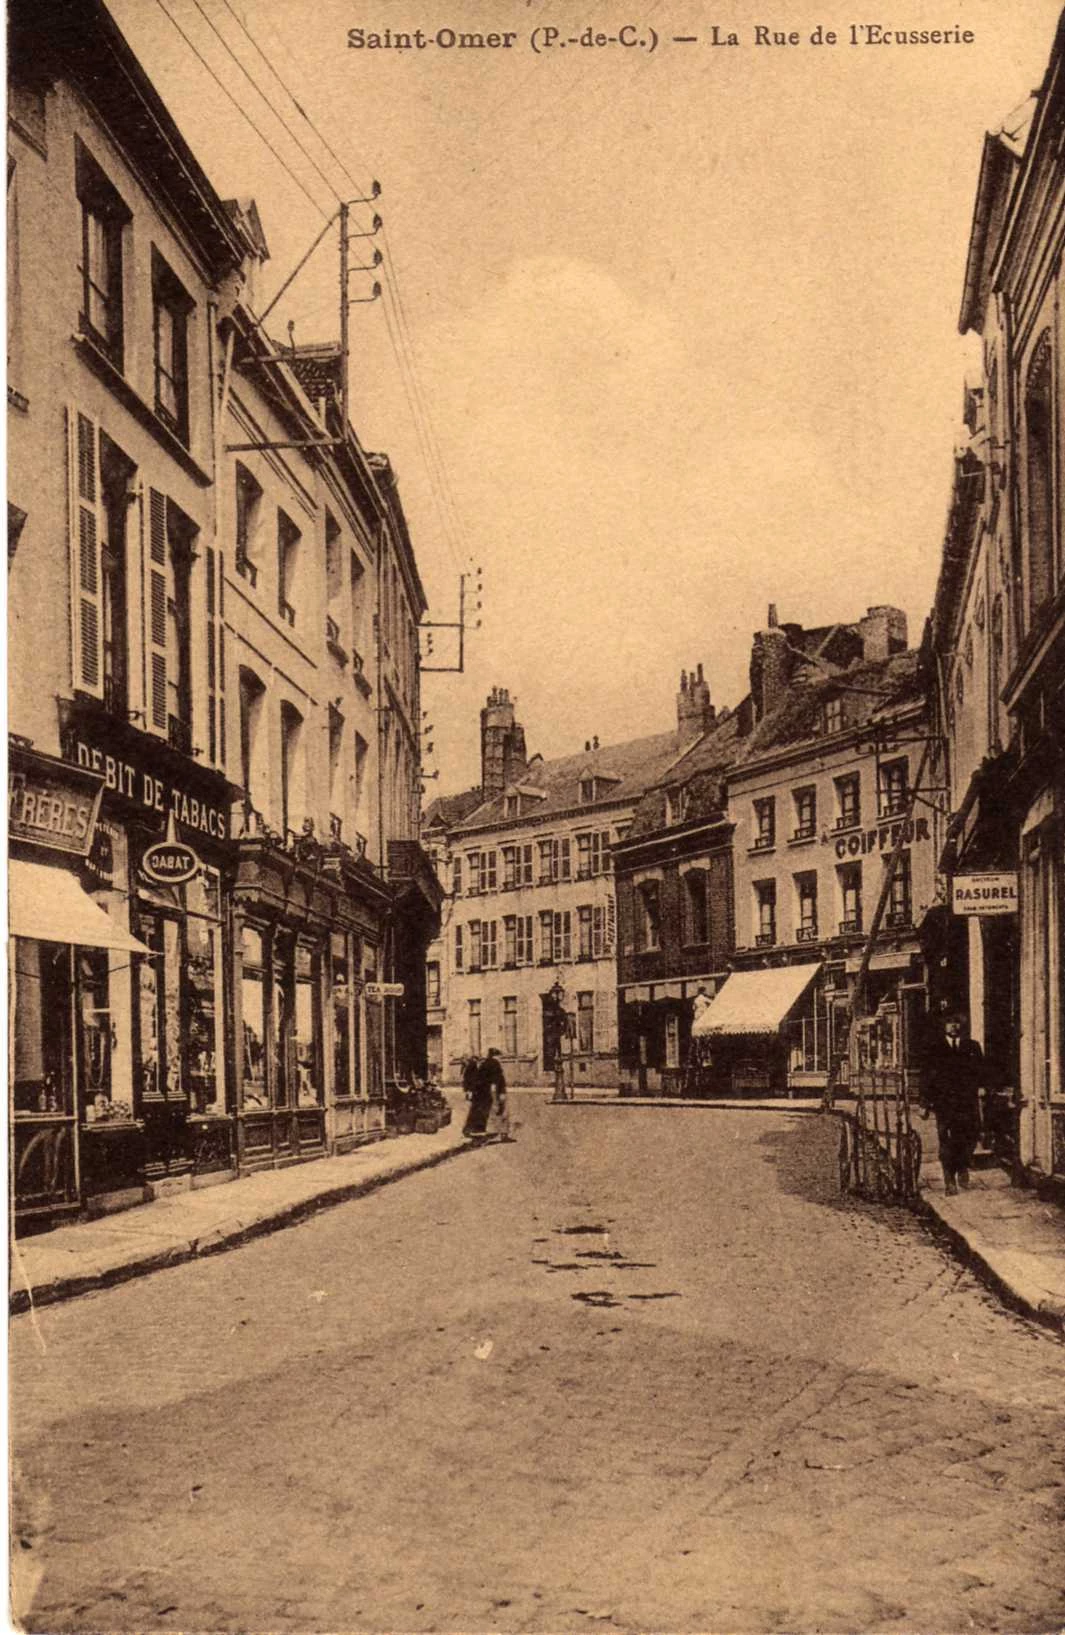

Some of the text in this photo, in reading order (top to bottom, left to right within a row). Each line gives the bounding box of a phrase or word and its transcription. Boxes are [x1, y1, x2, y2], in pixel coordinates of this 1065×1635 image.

[143, 773, 164, 812] DE
[171, 788, 225, 840] TABACS
[955, 886, 1017, 901] RASUREL
